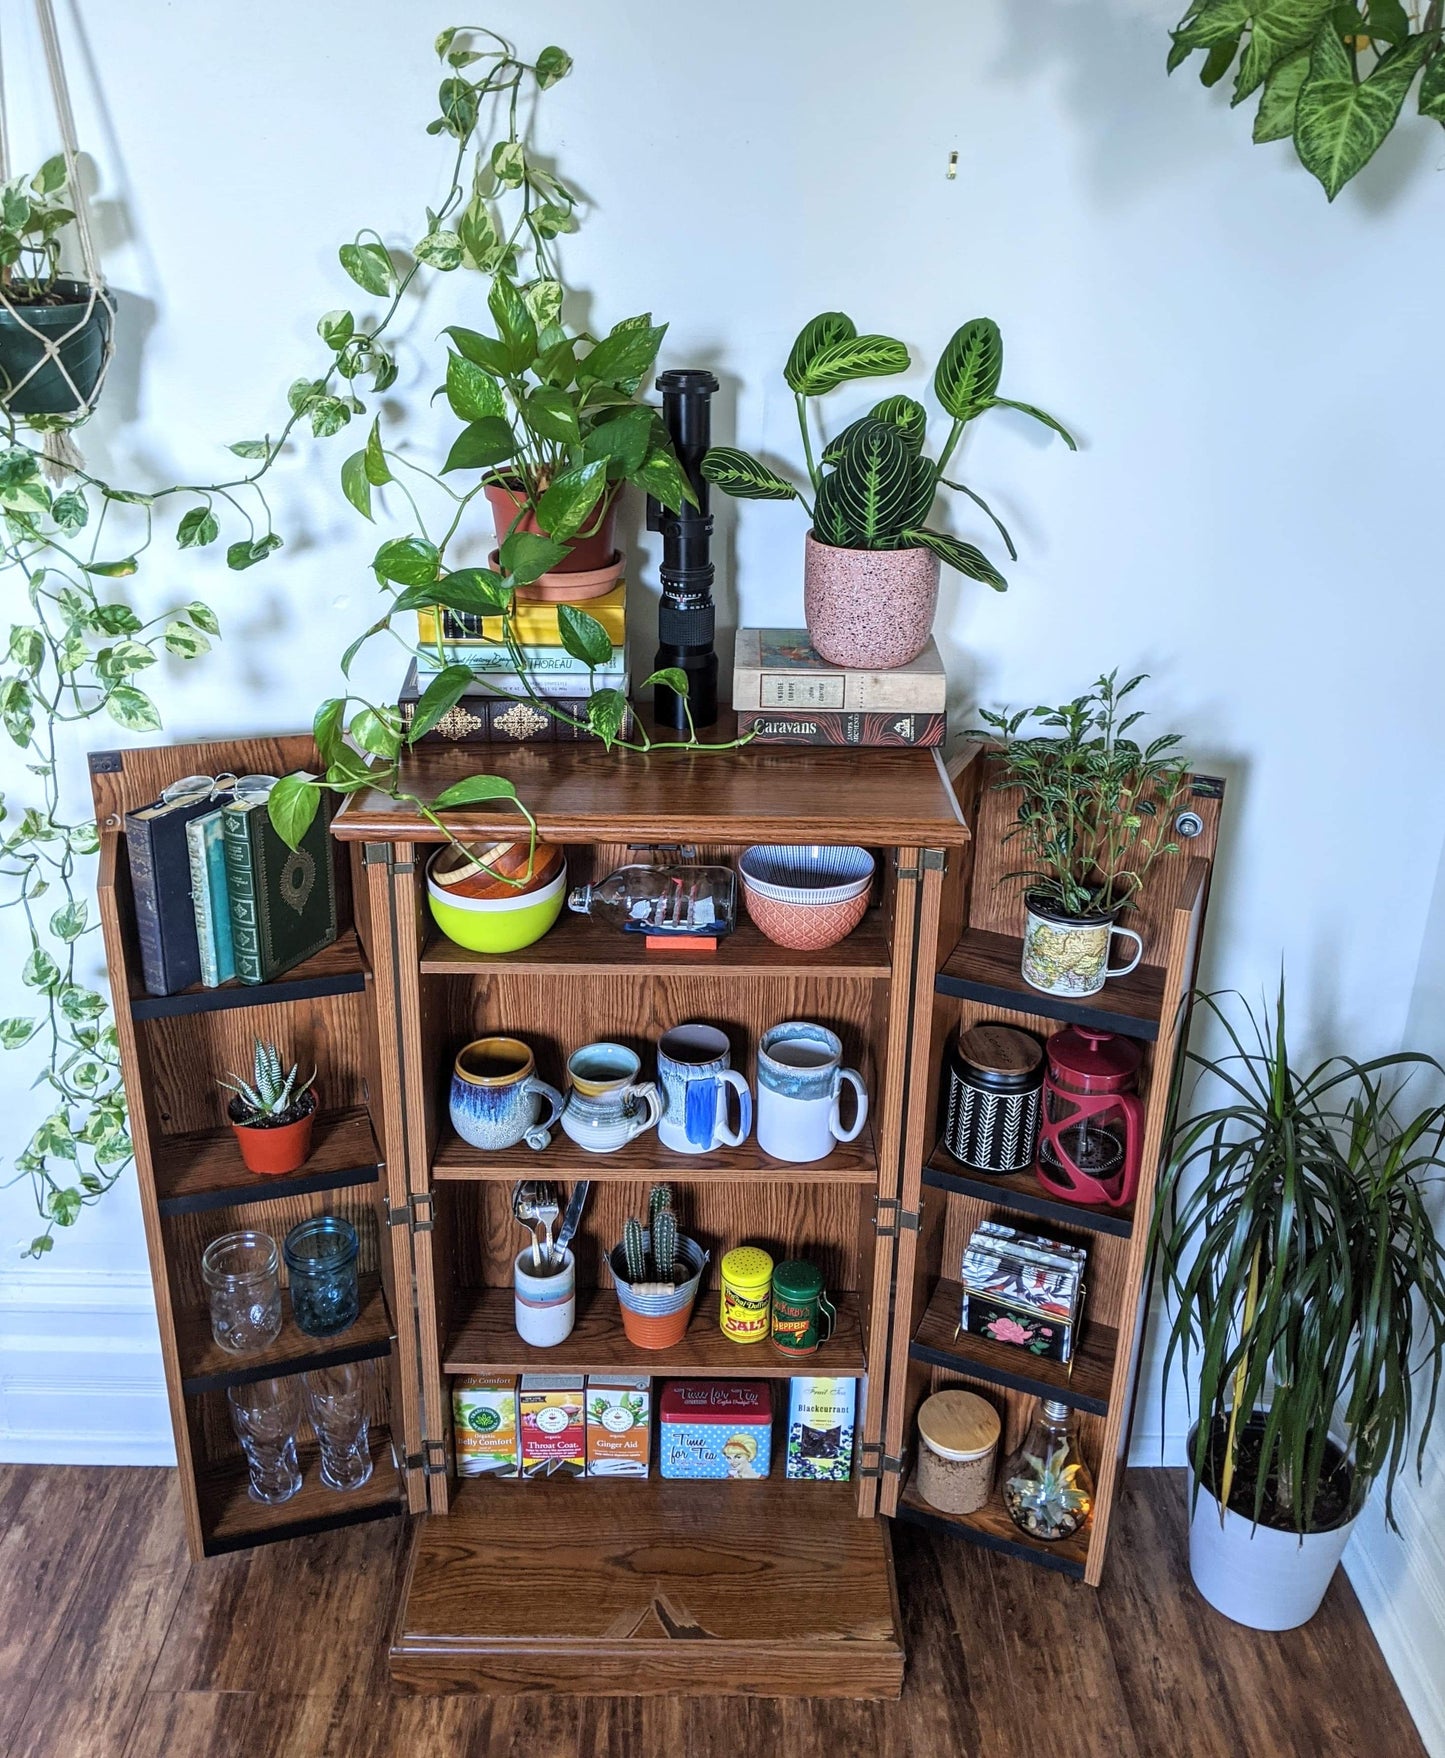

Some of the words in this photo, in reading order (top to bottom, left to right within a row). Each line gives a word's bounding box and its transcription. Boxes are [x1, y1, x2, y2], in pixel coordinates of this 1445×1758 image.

[754, 718, 817, 736] Caravans
[726, 1316, 767, 1331] SALT
[798, 1404, 850, 1414] Blackcurrant
[478, 1438, 512, 1447] Comfort
[527, 1441, 556, 1449] Throat
[596, 1440, 623, 1449] Ginger
[673, 1433, 706, 1447] Time
[670, 1446, 689, 1465] for
[691, 1447, 718, 1460] Tea
